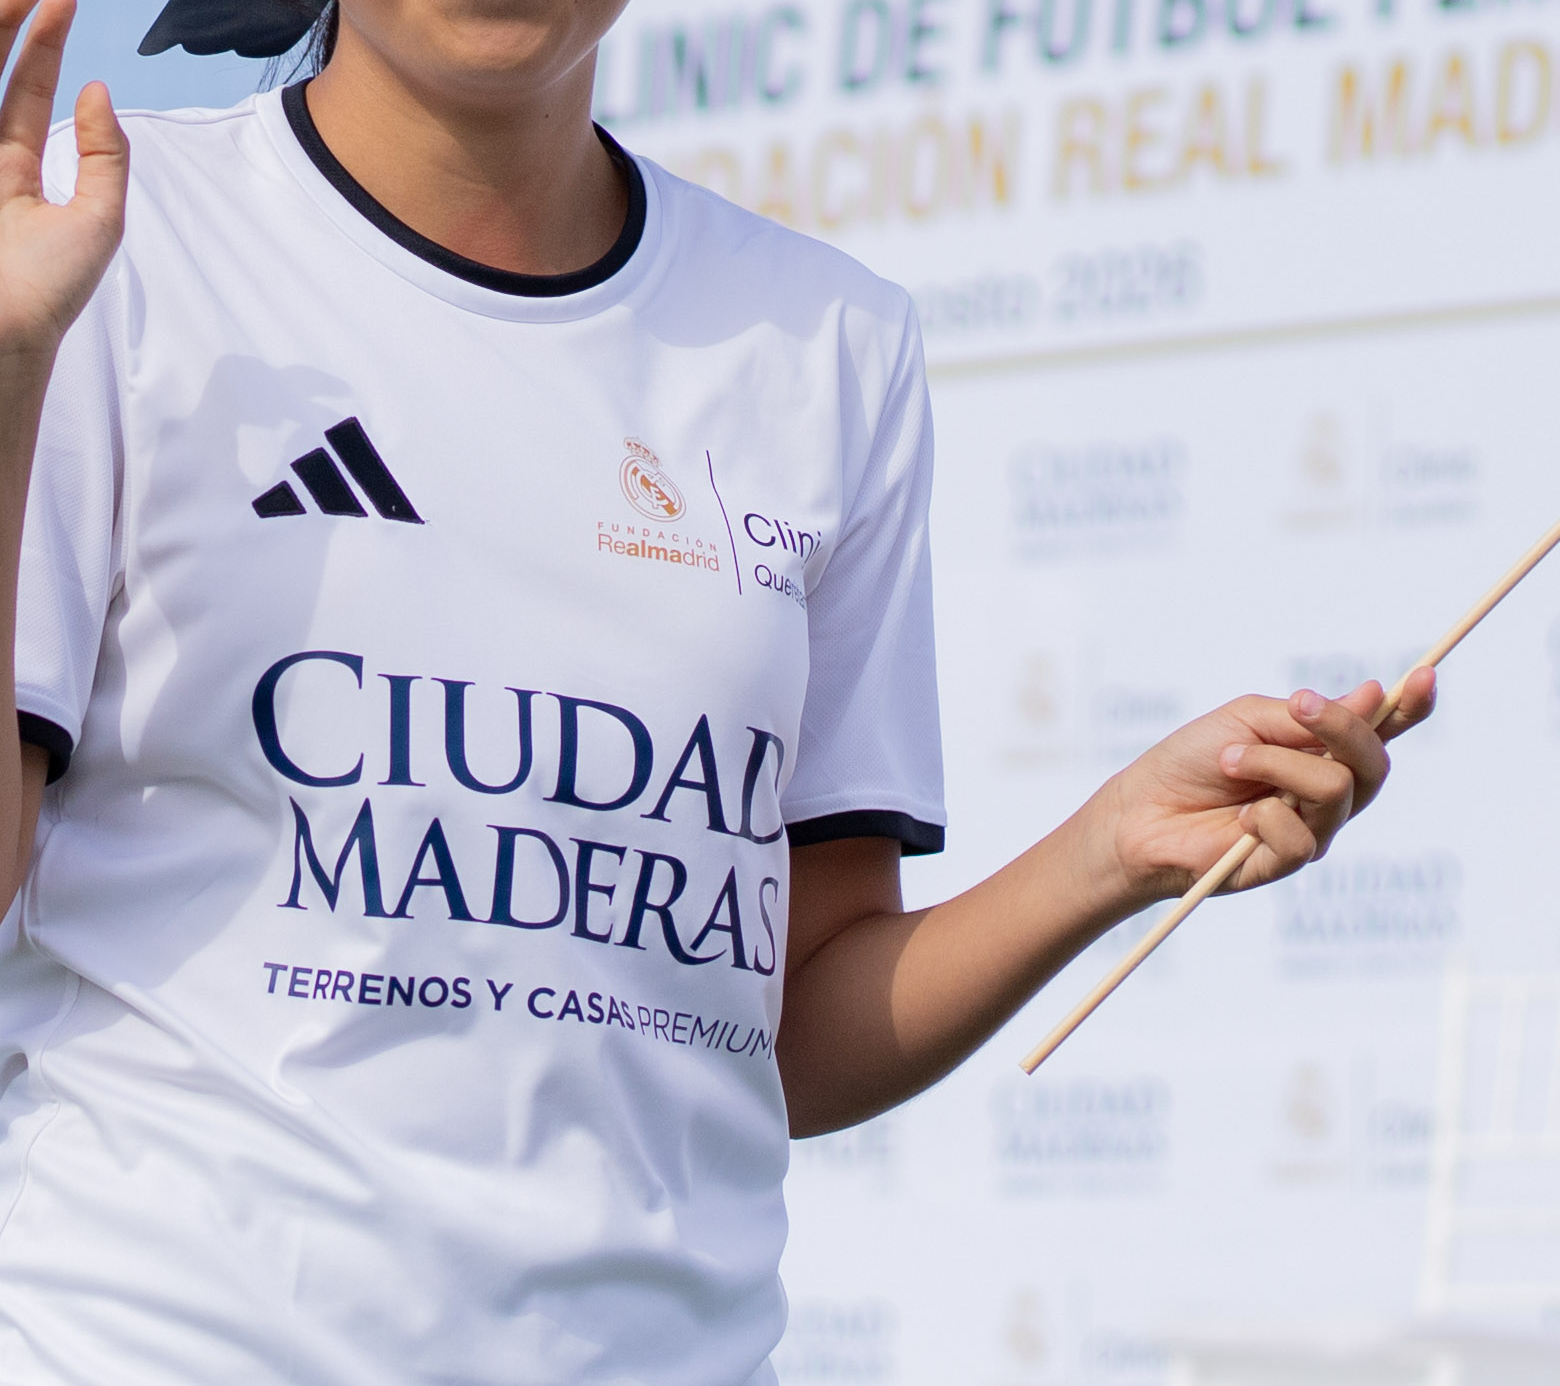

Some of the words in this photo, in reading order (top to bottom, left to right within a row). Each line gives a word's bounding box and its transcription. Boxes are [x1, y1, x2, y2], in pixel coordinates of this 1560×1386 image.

[1048, 65, 1290, 205] REAL
[597, 521, 718, 552] FUNDACIÓN
[597, 533, 720, 572] Realmadrid
[251, 650, 785, 845] CIUDAD
[278, 797, 779, 977] MADERAS
[263, 963, 472, 1009] TERRENOS
[486, 981, 514, 1011] Y
[527, 986, 637, 1034] CASAS
[638, 1006, 778, 1061] PREMIUM
